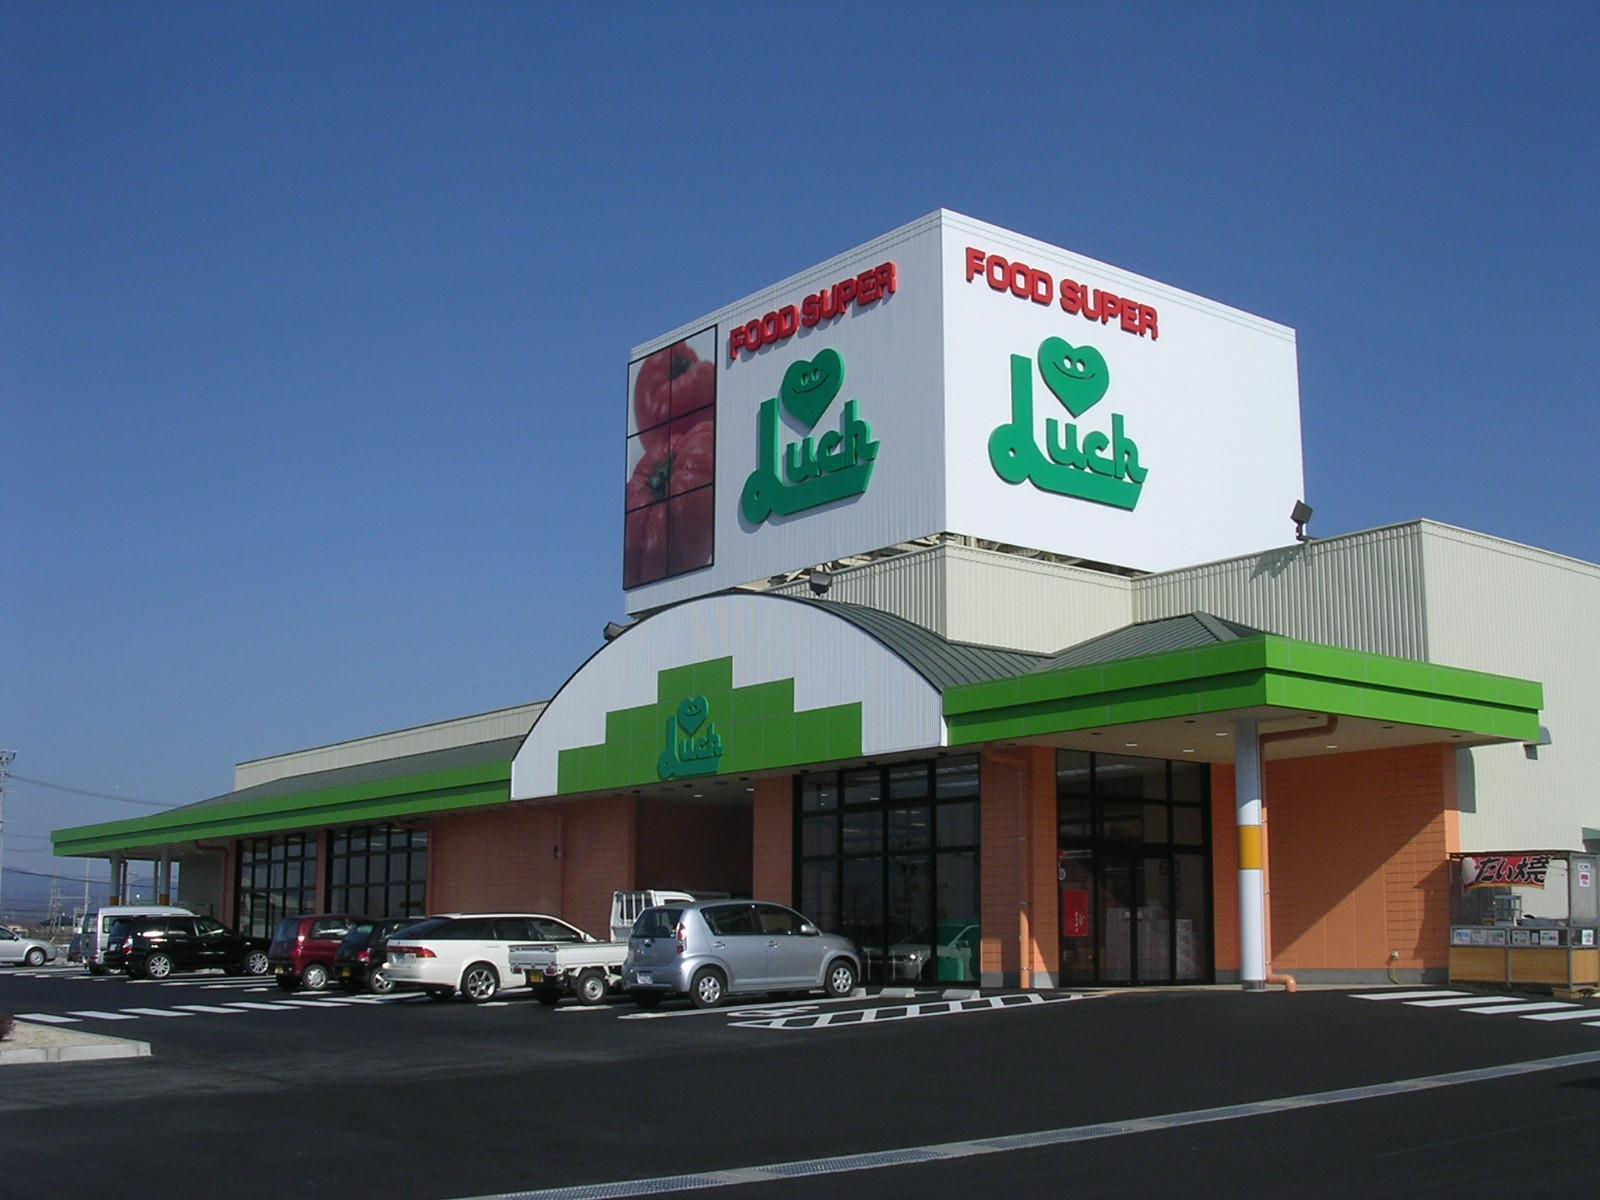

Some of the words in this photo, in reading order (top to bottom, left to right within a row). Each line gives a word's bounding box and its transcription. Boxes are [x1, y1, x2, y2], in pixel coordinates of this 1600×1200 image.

[729, 303, 800, 360] FOOD
[801, 261, 898, 328] SUPER
[965, 246, 1054, 306] FOOD
[1059, 279, 1159, 341] SUPER
